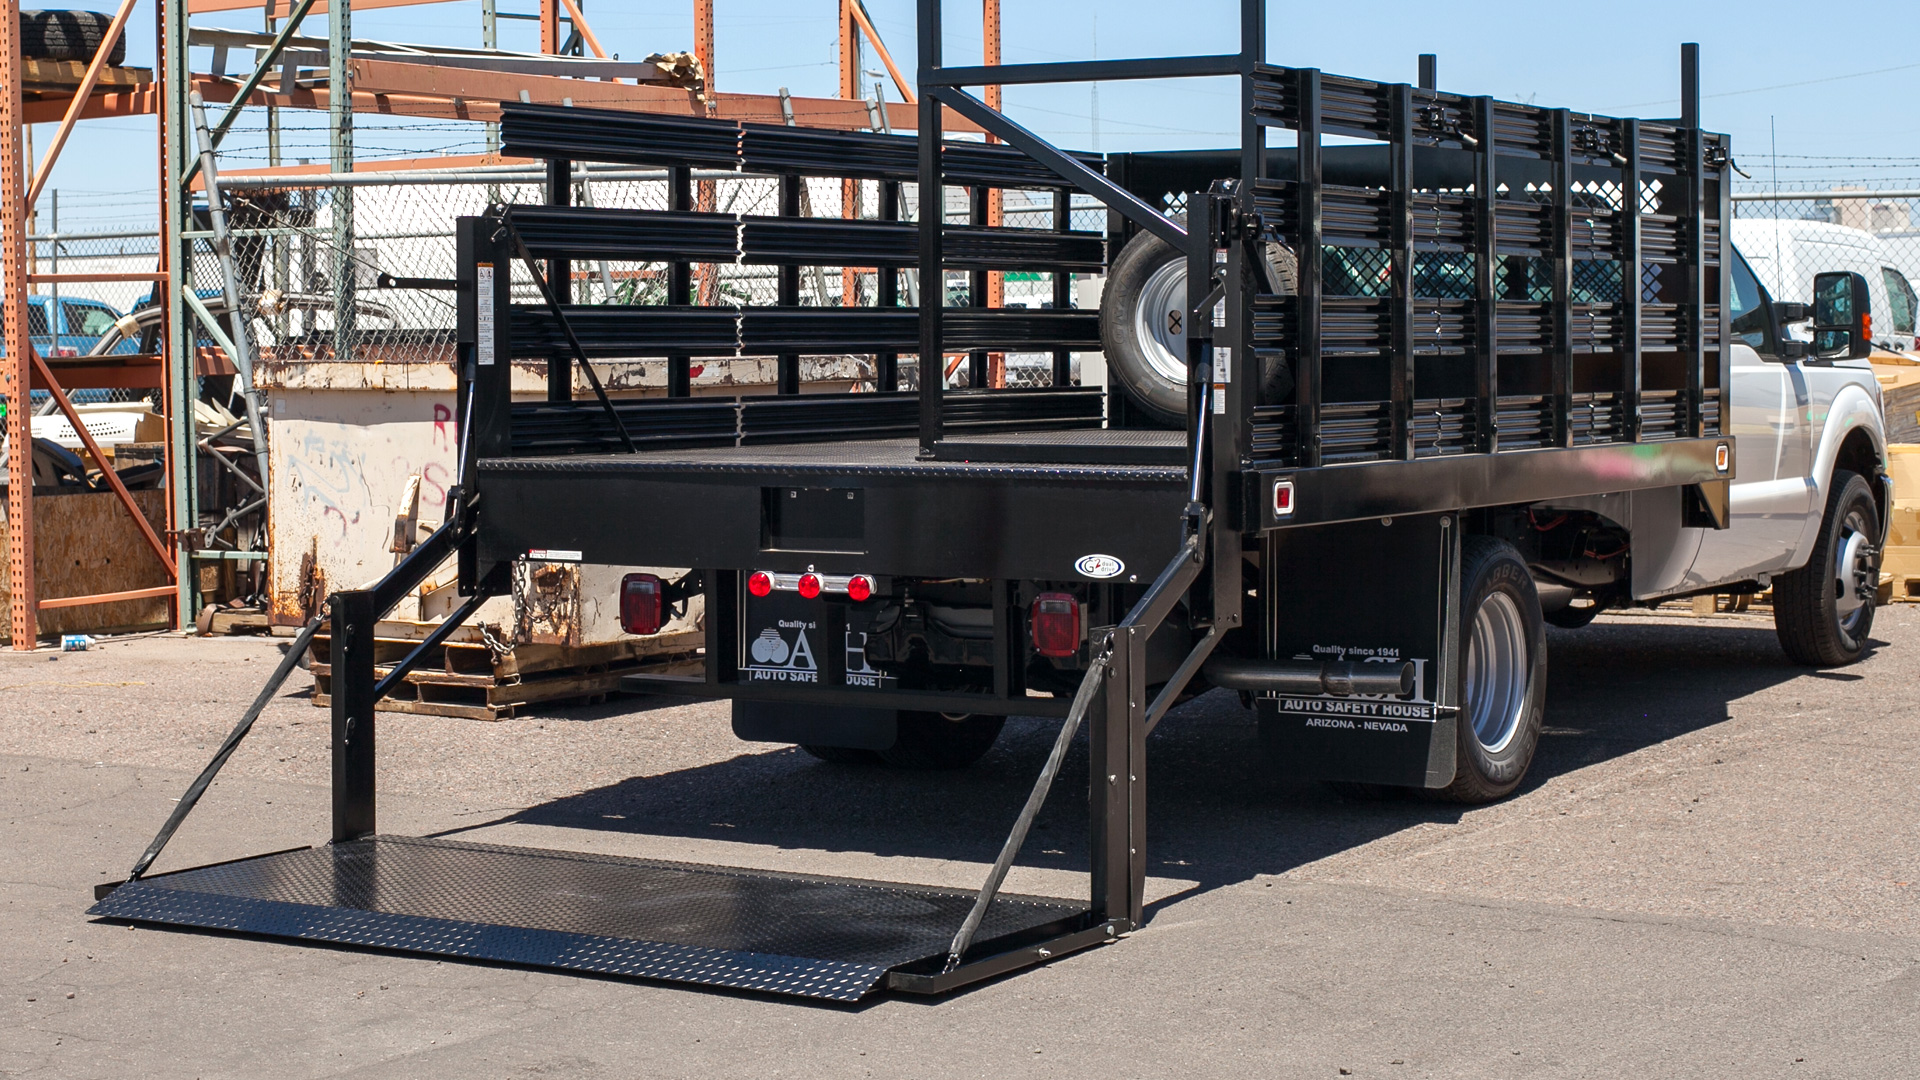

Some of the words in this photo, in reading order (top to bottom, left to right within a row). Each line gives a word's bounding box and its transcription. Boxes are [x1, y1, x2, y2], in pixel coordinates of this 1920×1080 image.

[778, 619, 807, 630] Quality
[1312, 644, 1346, 656] Quality
[1348, 646, 1375, 656] since
[1376, 647, 1400, 657] 1941
[754, 670, 787, 681] AUTO
[789, 671, 818, 683] SAFE
[1284, 699, 1322, 712] AUTO
[1325, 701, 1378, 715] SAFETY
[1382, 704, 1430, 718] HOUSE
[1306, 718, 1355, 729] ARIZONA
[1364, 721, 1408, 733] NEVADA
